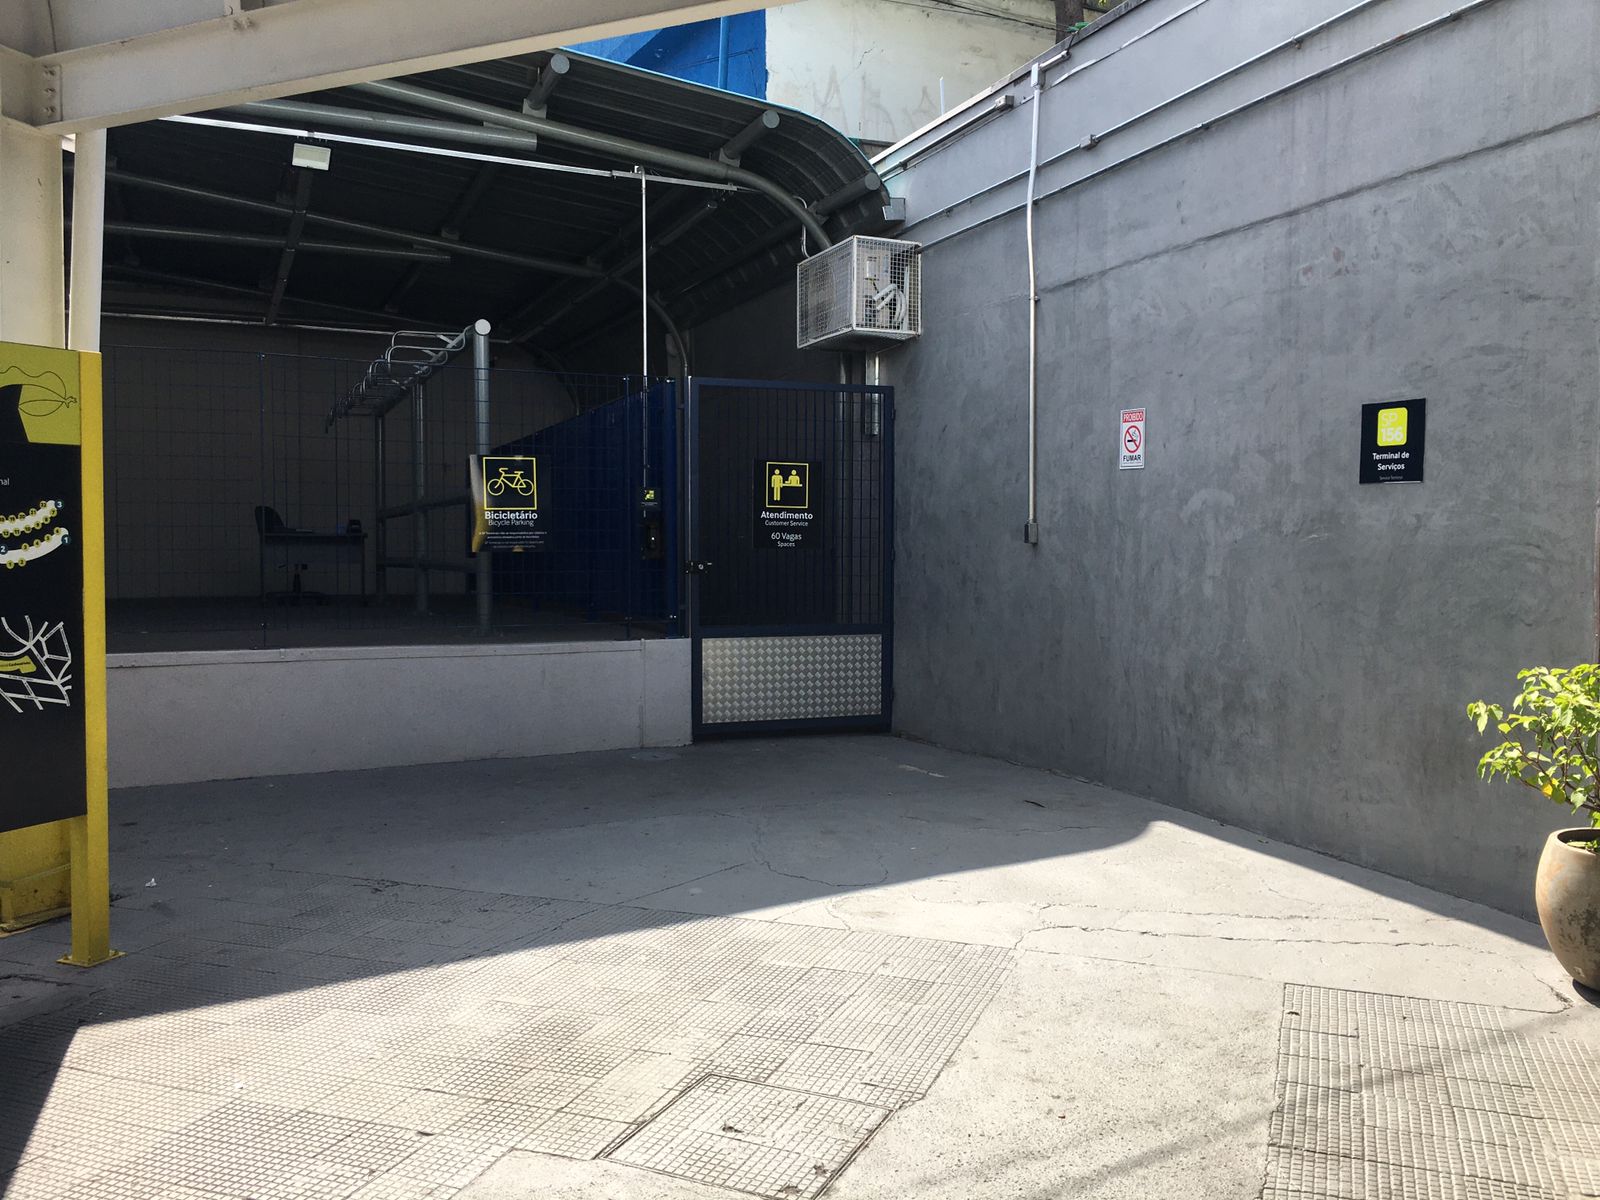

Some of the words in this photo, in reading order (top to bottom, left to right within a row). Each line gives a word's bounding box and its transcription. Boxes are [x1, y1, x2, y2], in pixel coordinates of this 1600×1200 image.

[1123, 412, 1143, 422] PROIBIDO
[1381, 412, 1398, 426] SP
[1381, 427, 1403, 442] 156
[1372, 451, 1400, 460] Terminal
[1401, 451, 1410, 459] de
[1377, 462, 1405, 471] Serviços
[484, 511, 538, 520] Bicicletário
[760, 511, 814, 519] Atendimento
[511, 519, 535, 527] Parking
[771, 531, 781, 540] 60
[781, 532, 802, 542] Vagas
[777, 540, 796, 548] Spaces
[0, 545, 6, 553] 2
